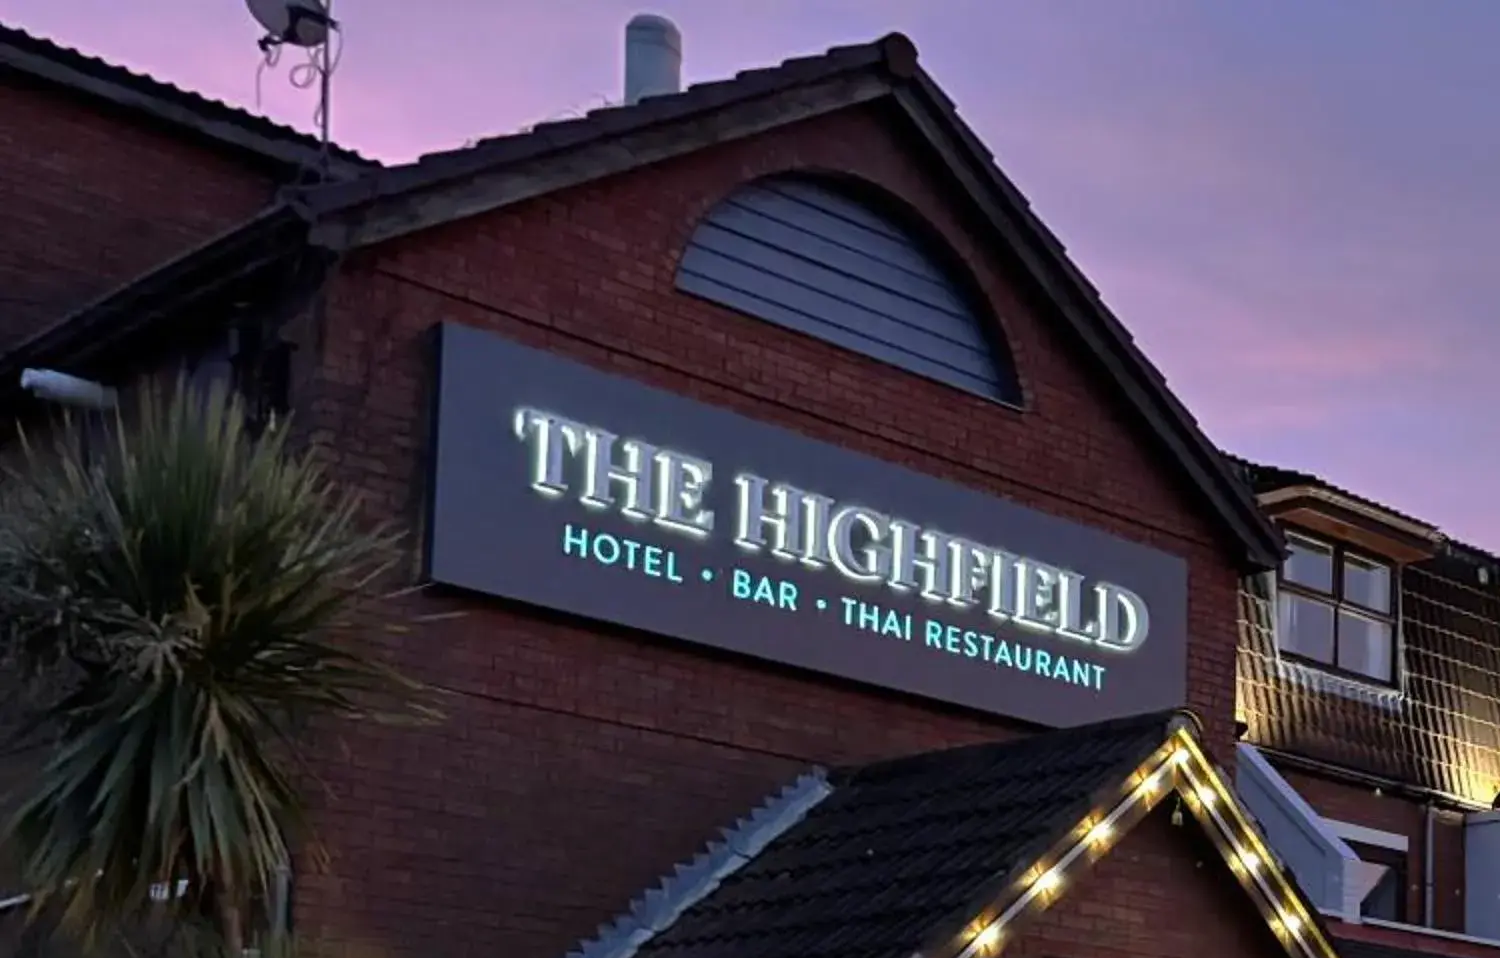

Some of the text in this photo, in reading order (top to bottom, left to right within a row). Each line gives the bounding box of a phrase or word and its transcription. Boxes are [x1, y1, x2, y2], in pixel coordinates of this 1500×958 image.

[514, 406, 1151, 652] THE HIGHFIELD
[562, 523, 1107, 691] HOTEL BAR THAI RESTAURANT
